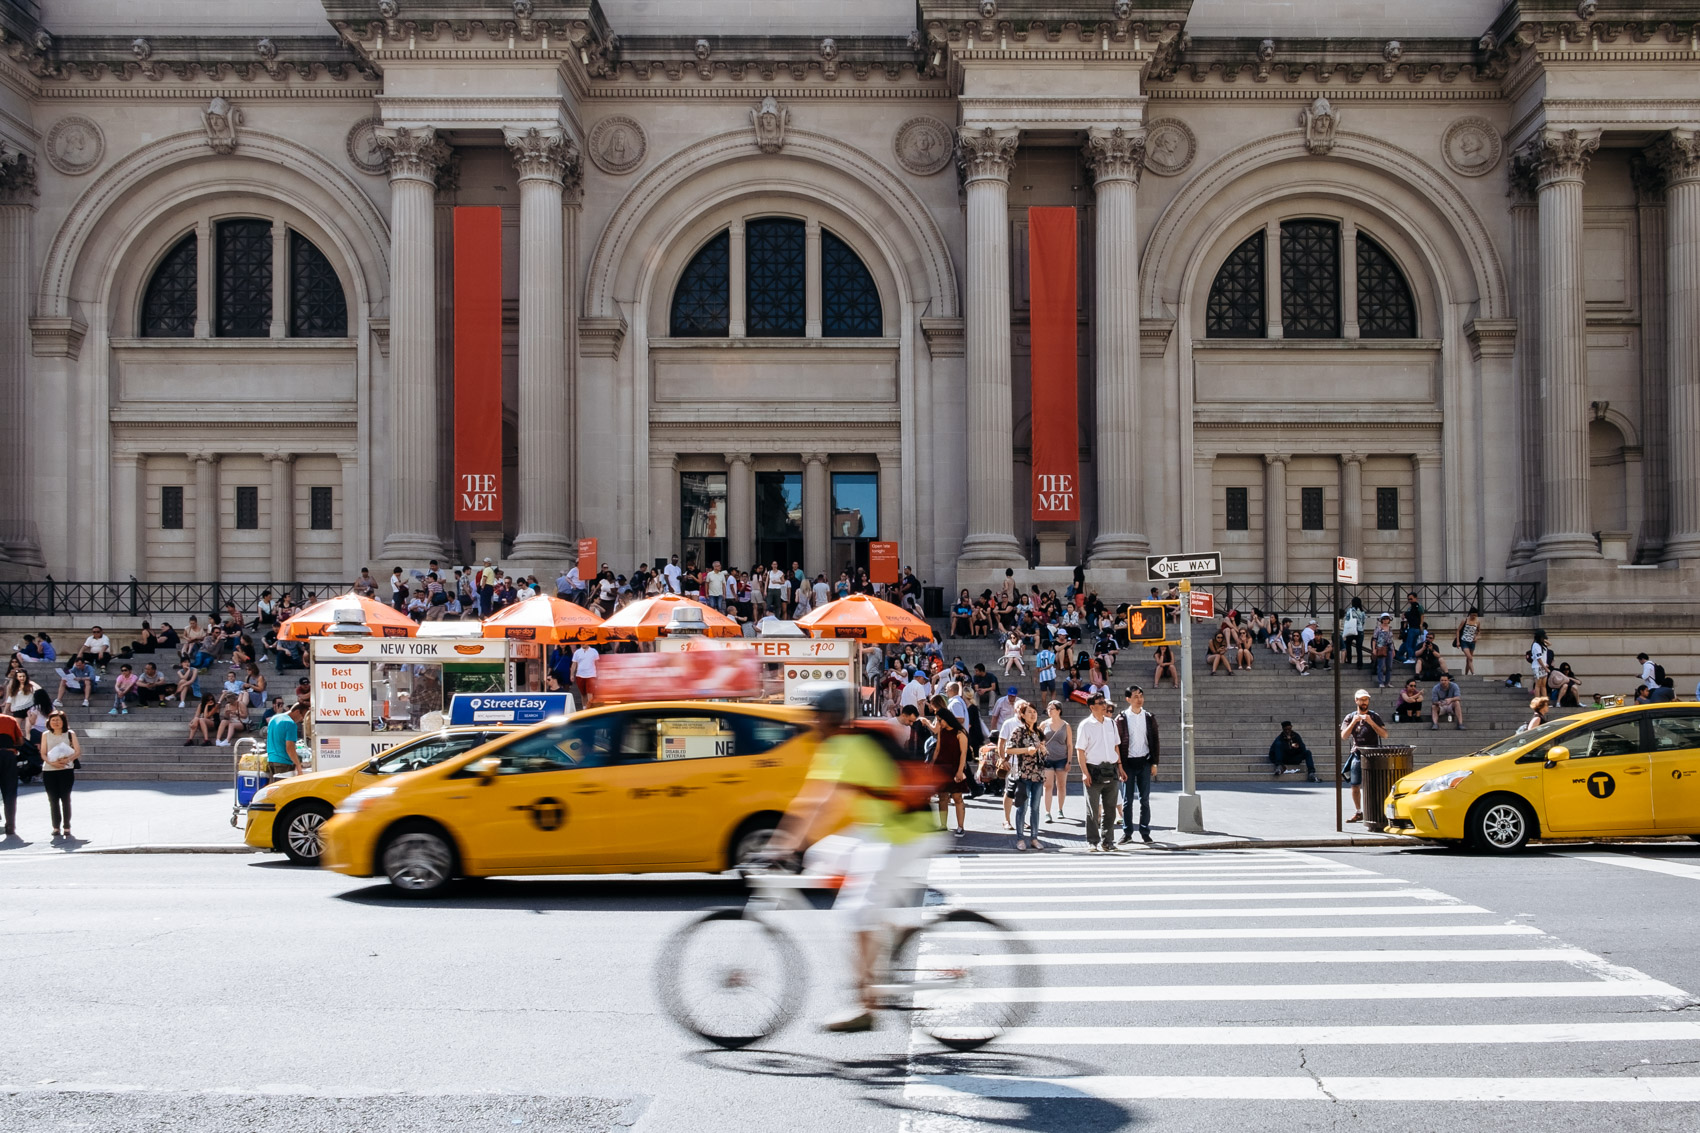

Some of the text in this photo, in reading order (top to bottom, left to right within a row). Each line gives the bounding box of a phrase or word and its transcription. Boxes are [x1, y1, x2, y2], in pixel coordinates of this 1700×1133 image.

[462, 474, 496, 492] THE
[1038, 474, 1072, 492] THE
[461, 493, 497, 511] MET
[1038, 493, 1073, 511] MET
[1159, 560, 1211, 572] ONE WAY
[381, 644, 438, 654] NEW YORK
[810, 642, 835, 656] $1.00
[331, 668, 351, 676] Best
[321, 681, 364, 691] Hot Dogs
[338, 694, 347, 703] in
[483, 698, 546, 710] StreetEasy
[320, 708, 365, 717] New York
[1592, 776, 1608, 796] T
